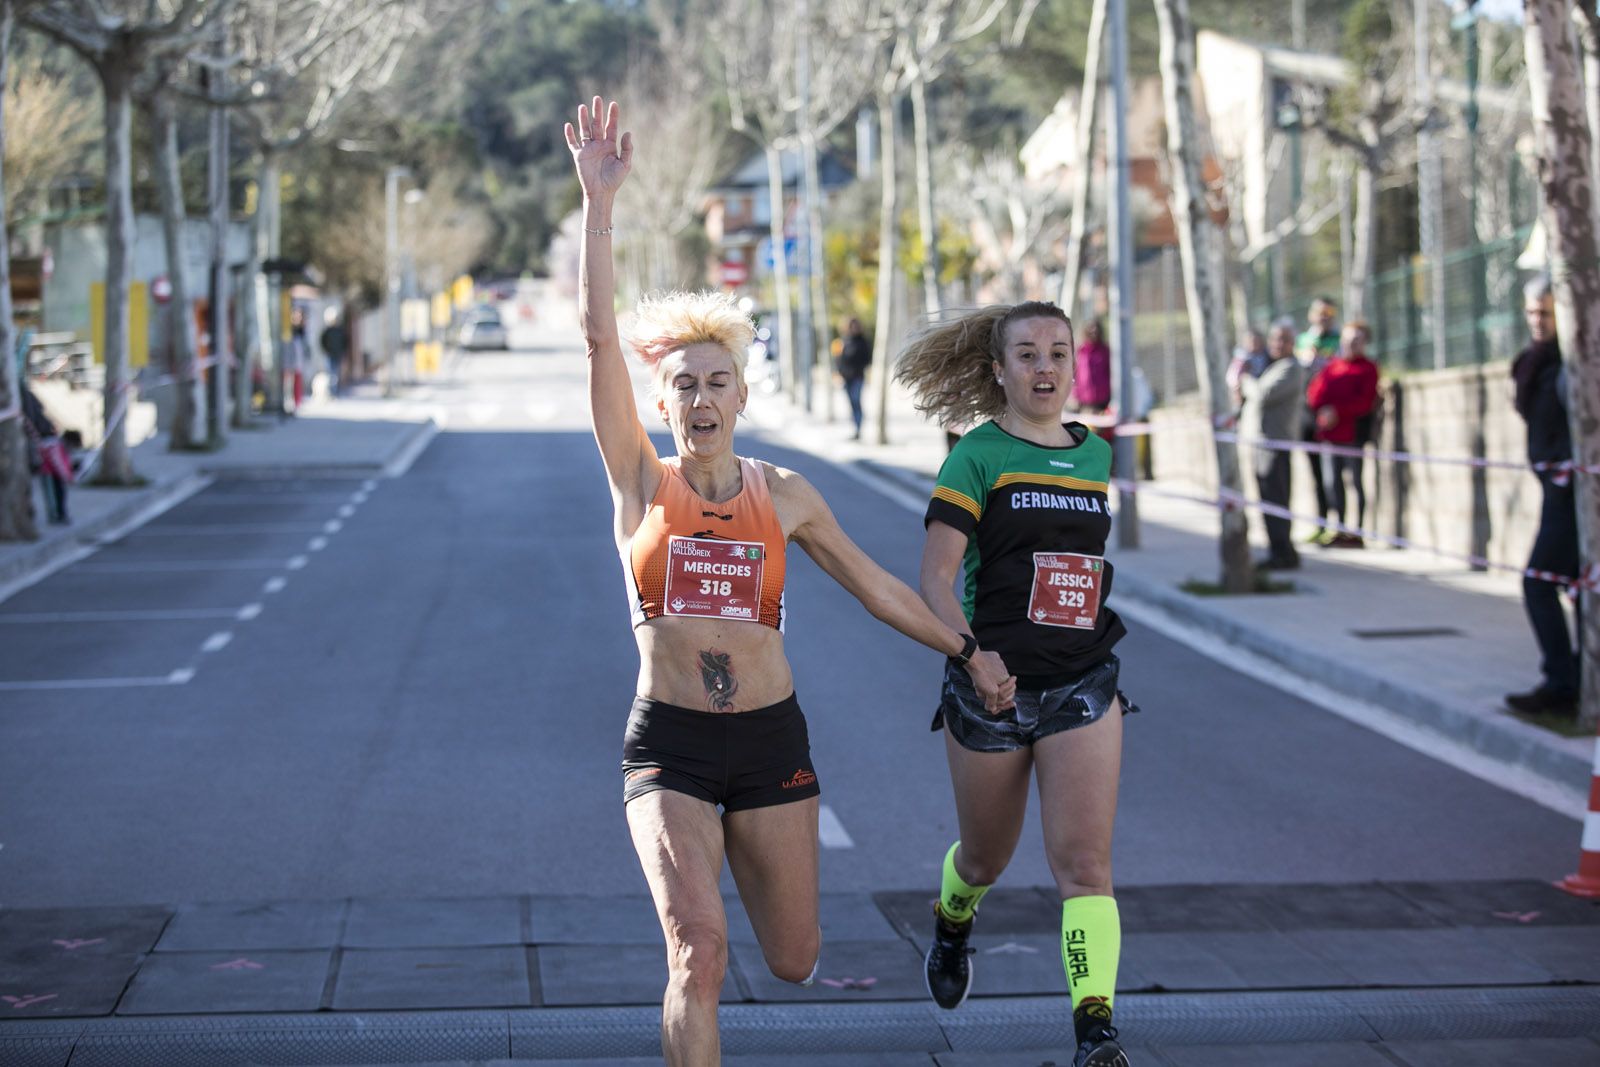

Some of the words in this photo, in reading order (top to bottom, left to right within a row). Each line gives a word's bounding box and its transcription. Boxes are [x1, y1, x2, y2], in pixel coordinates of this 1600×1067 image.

[1011, 492, 1101, 513] CERDANYOLA
[672, 541, 696, 549] MILLES
[672, 547, 711, 557] VALLDOREIX
[684, 561, 751, 577] MERCEDES
[699, 579, 732, 596] 318
[1048, 572, 1094, 589] JESSICA
[1058, 590, 1085, 608] 329
[1065, 928, 1089, 987] SURAL
